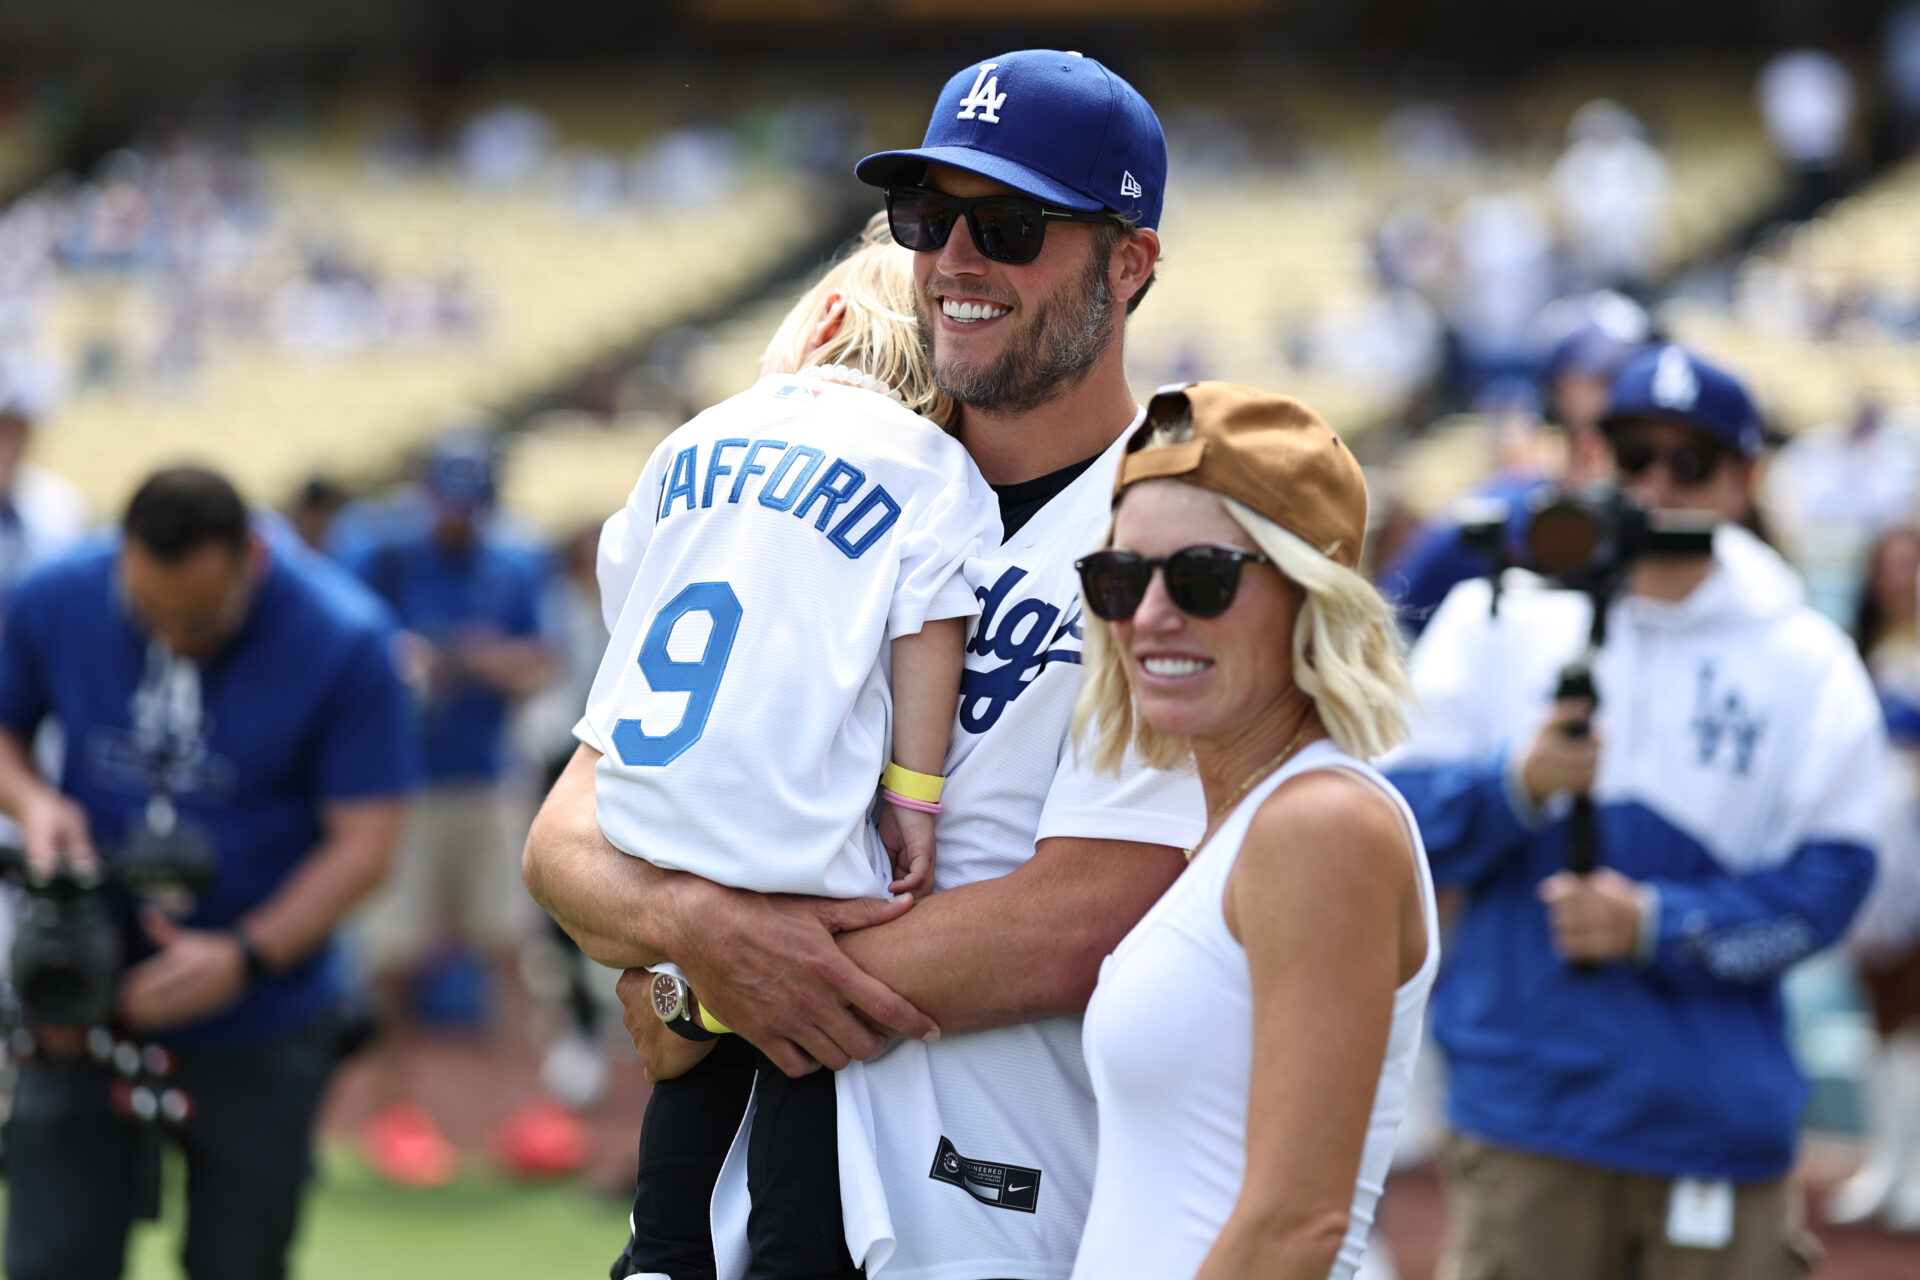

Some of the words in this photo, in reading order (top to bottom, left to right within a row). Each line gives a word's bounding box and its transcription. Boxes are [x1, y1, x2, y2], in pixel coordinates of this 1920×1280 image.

[957, 64, 1007, 124] LA
[656, 438, 901, 559] AFFORD
[612, 581, 743, 766] 9
